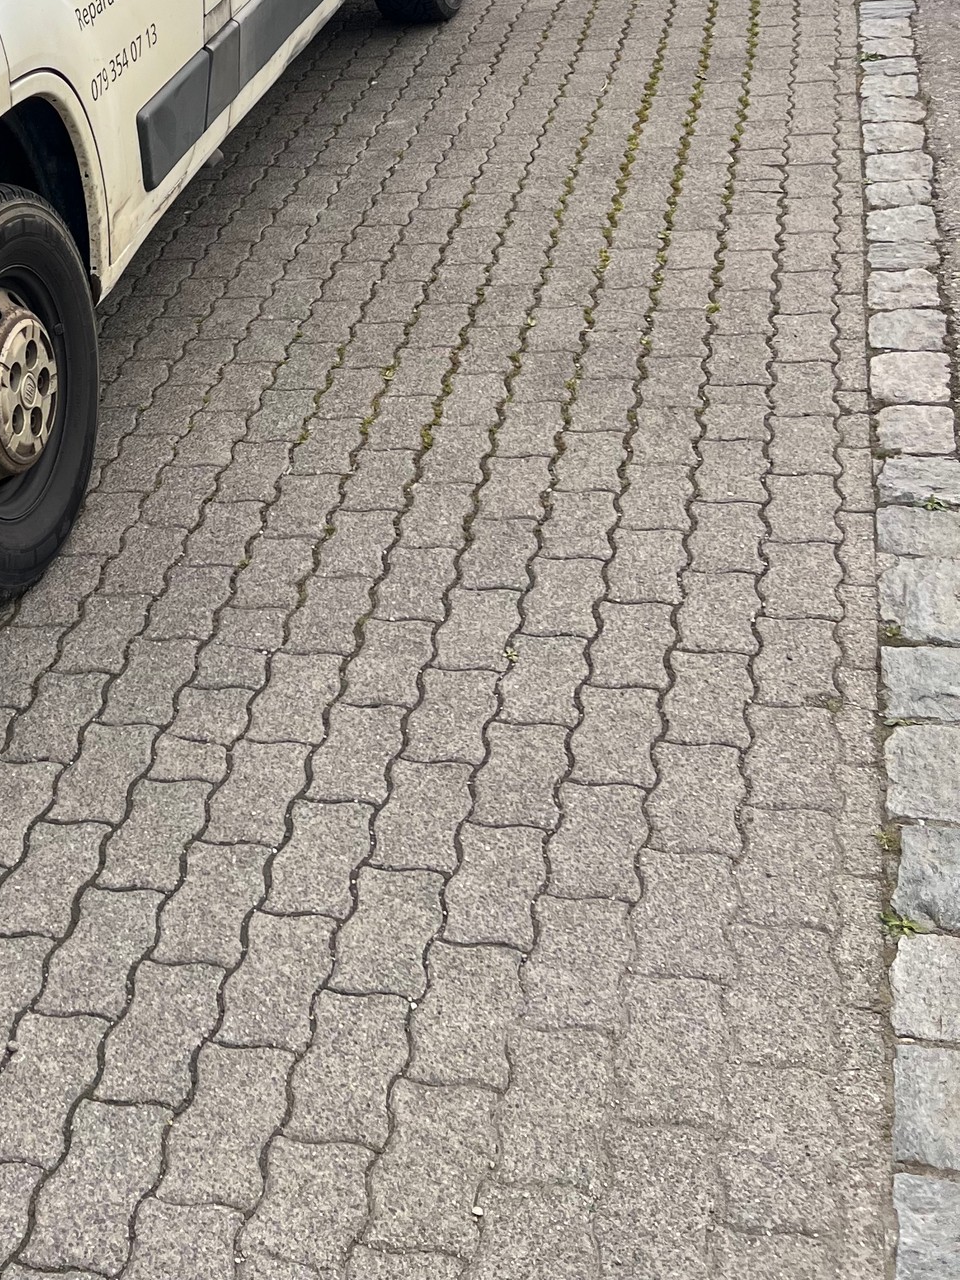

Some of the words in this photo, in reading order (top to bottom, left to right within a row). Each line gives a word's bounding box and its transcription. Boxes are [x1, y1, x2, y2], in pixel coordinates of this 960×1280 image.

[91, 68, 109, 101] 079
[109, 47, 129, 82] 354
[130, 34, 142, 62] 07
[145, 23, 157, 48] 13
